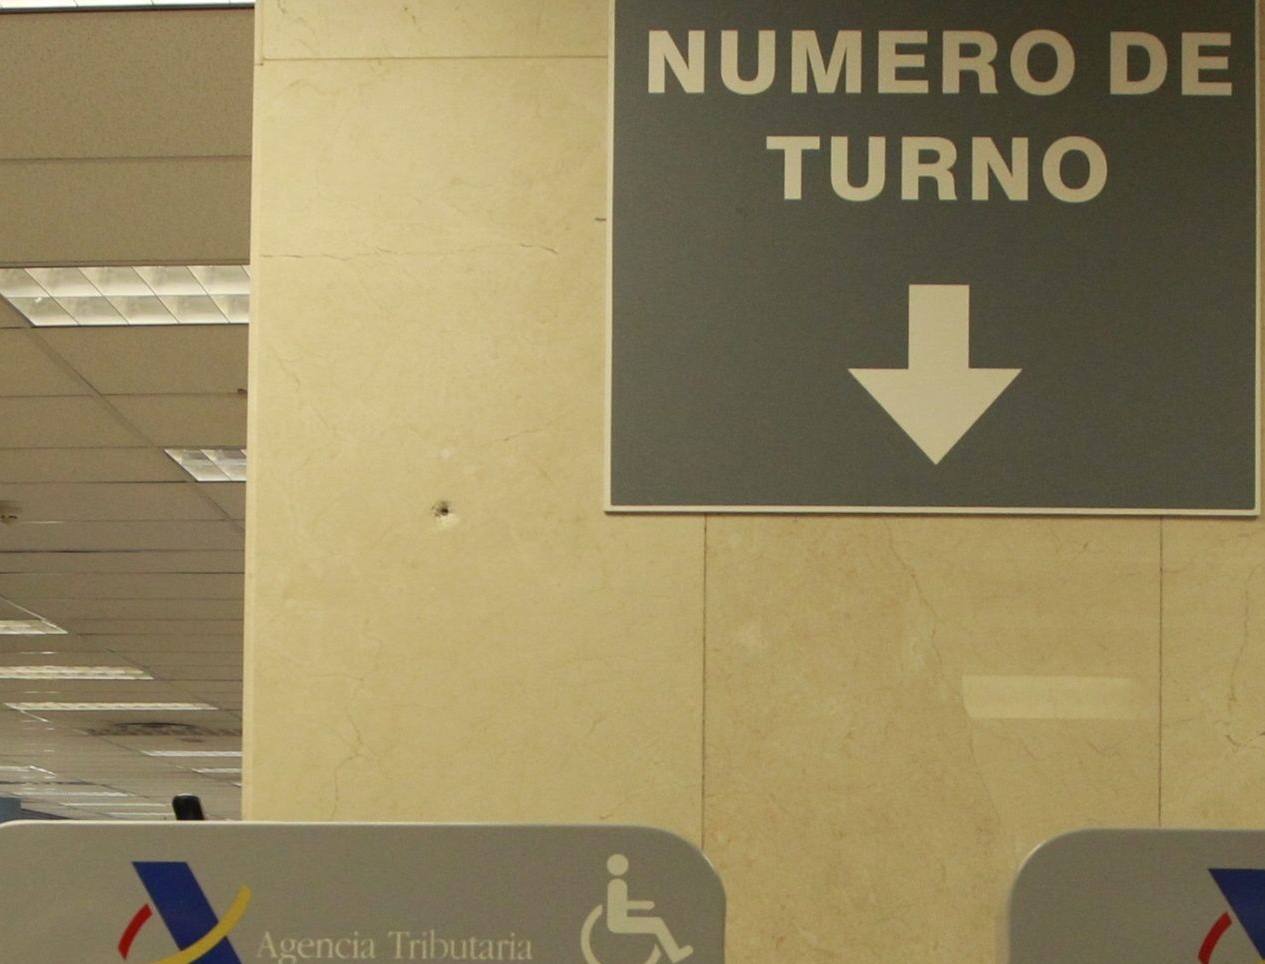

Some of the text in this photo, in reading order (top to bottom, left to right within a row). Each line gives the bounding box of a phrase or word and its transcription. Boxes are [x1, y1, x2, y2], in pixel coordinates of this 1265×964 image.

[647, 29, 1233, 96] NUMERO DE
[766, 136, 1109, 203] TURNO
[387, 930, 533, 961] Tributaria
